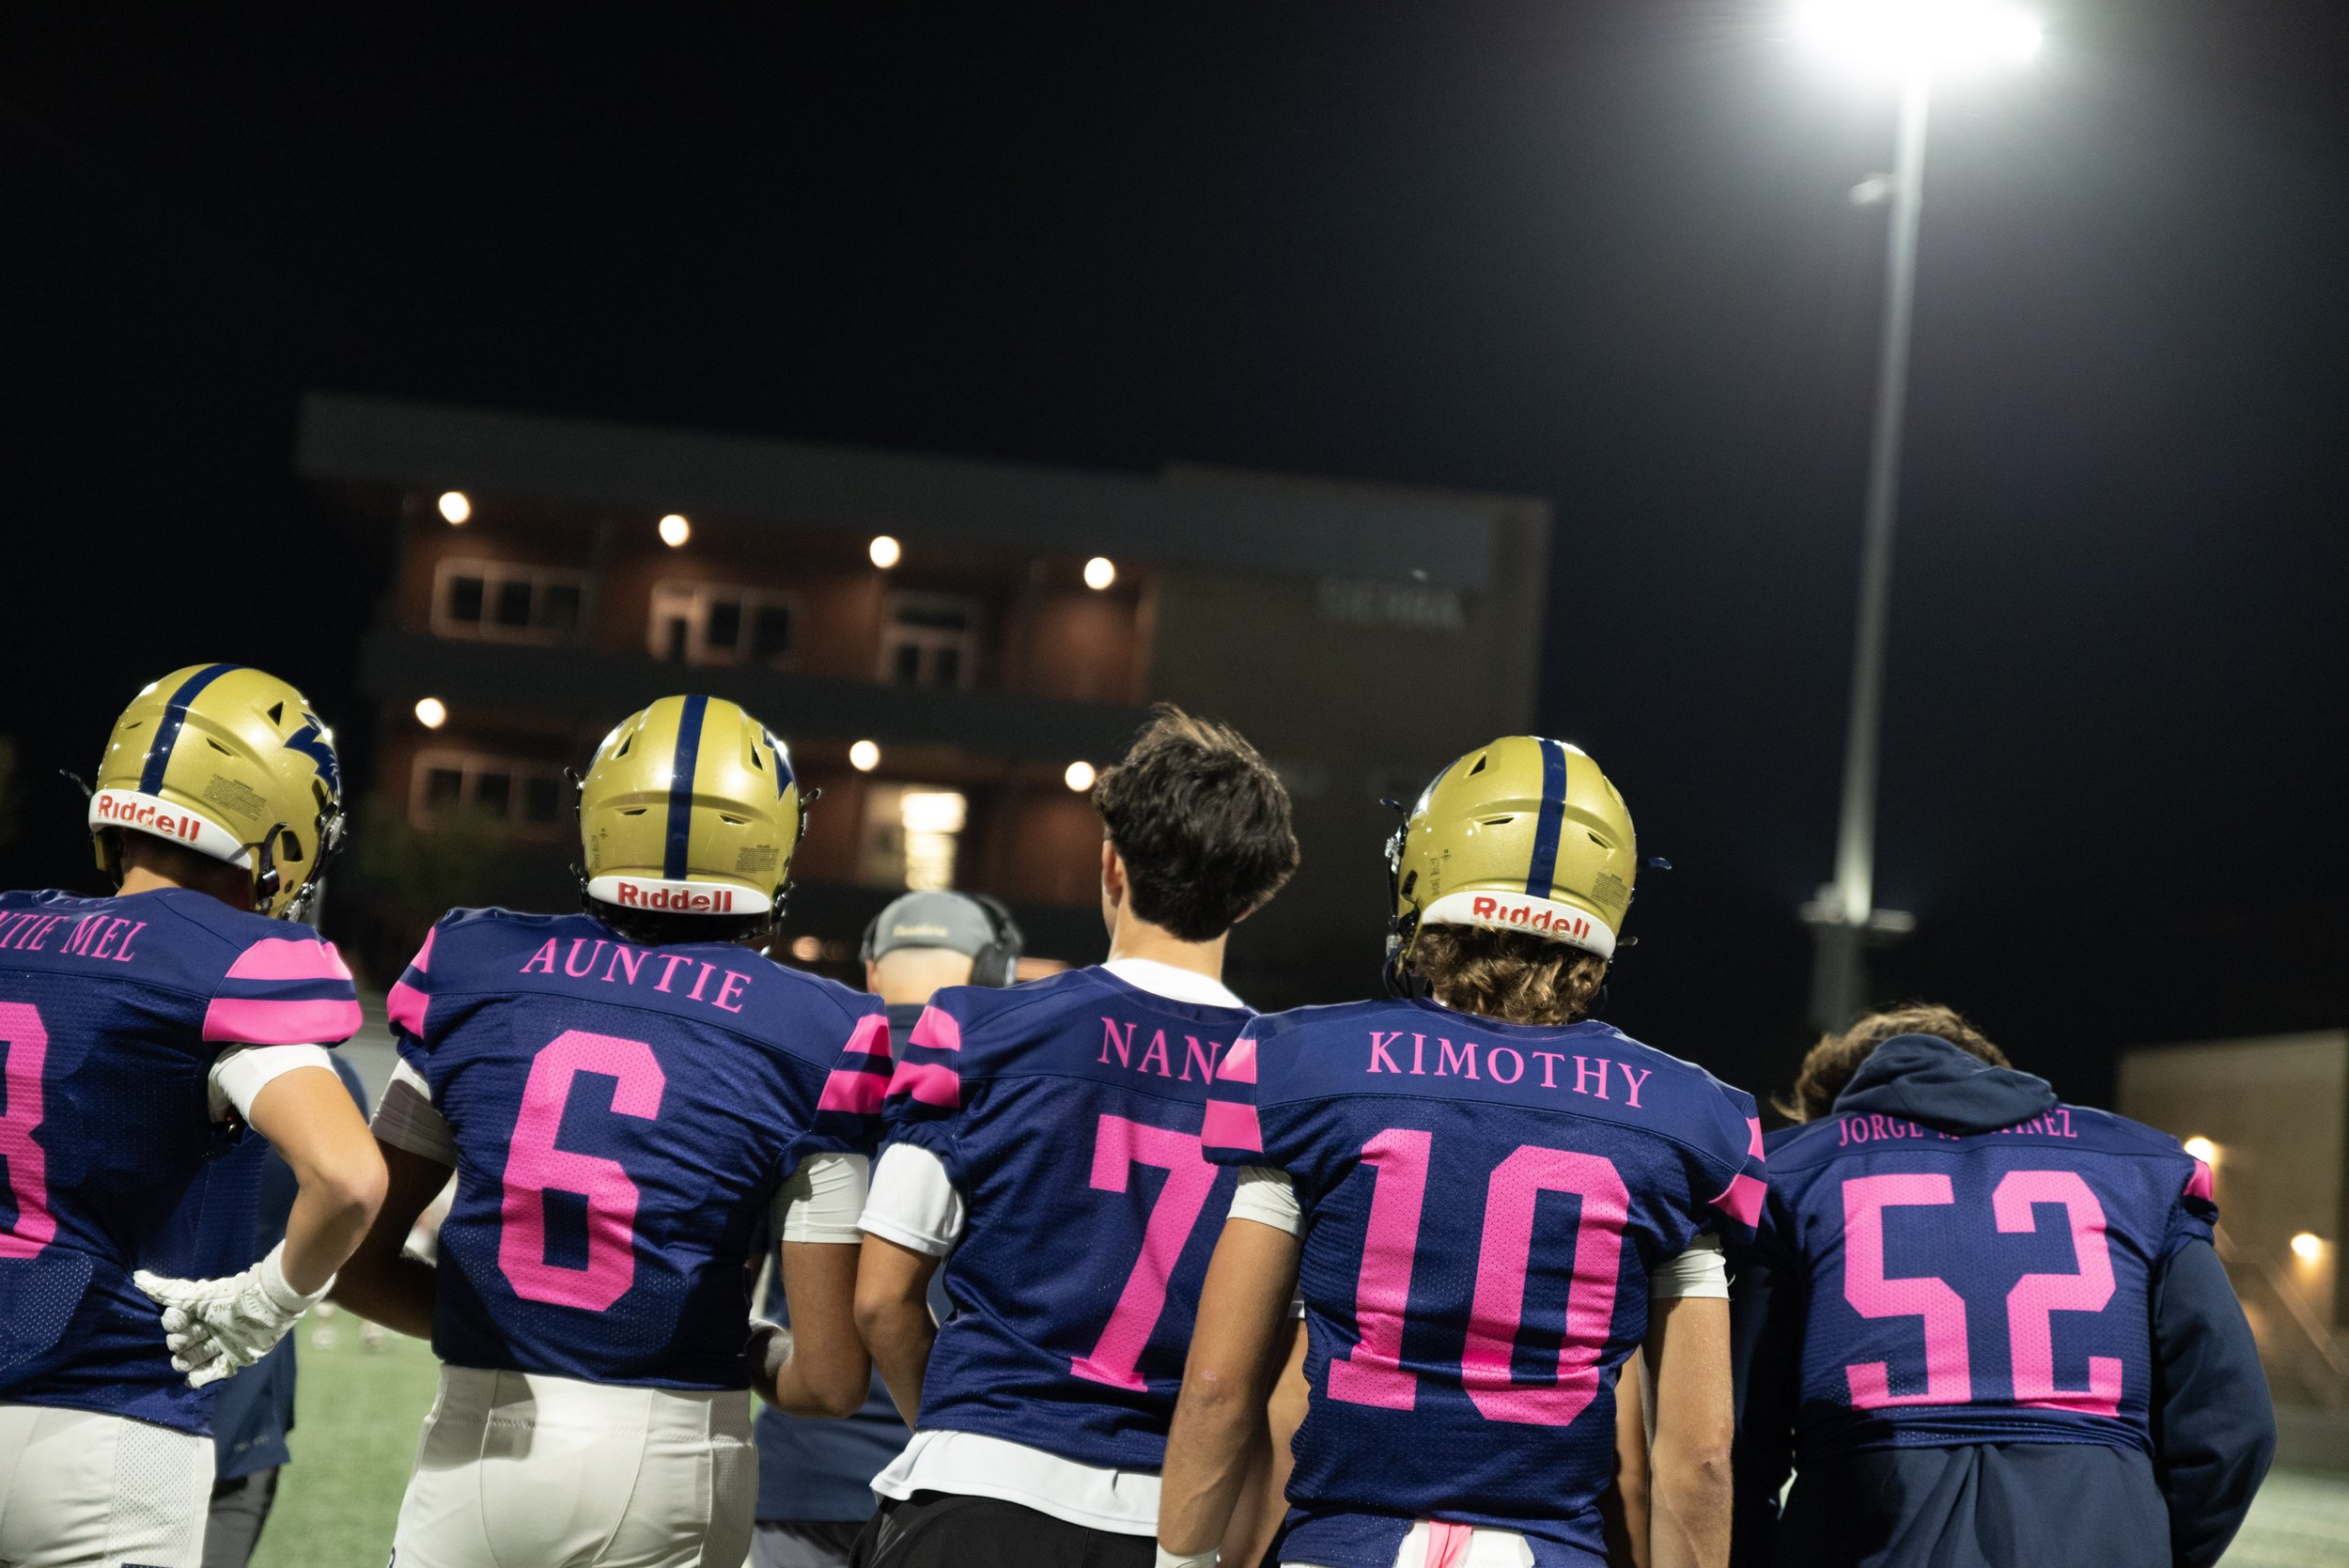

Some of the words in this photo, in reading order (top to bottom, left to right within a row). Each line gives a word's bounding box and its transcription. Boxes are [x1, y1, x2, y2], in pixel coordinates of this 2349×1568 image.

[98, 794, 201, 842] Riddell
[617, 881, 732, 912] Riddell
[1472, 896, 1591, 939] Riddell
[59, 915, 148, 962] MEL
[520, 938, 752, 1014] AUNTIE
[1366, 1032, 1653, 1109] KIMOTHY
[497, 1028, 666, 1312] 6
[1069, 1113, 1220, 1393] 7
[1327, 1127, 1630, 1427] 10
[1841, 1169, 2123, 1419] 52
